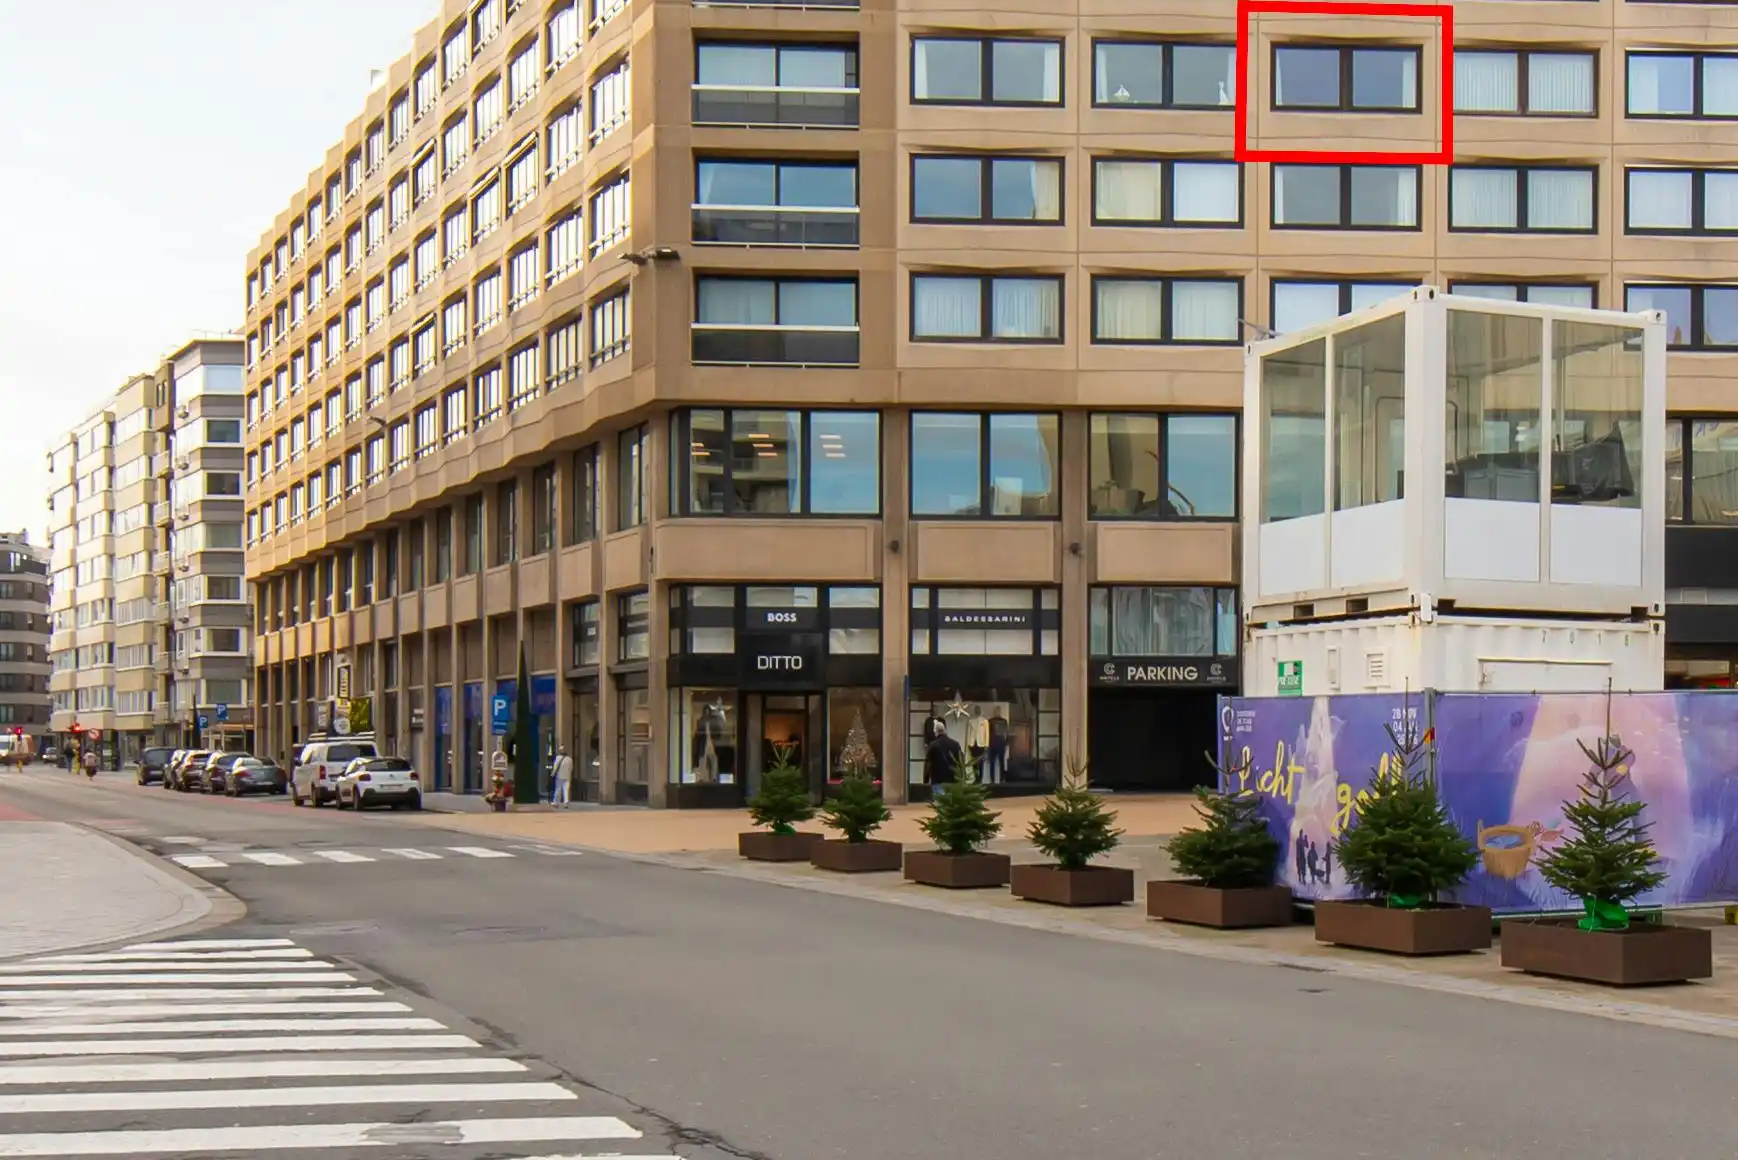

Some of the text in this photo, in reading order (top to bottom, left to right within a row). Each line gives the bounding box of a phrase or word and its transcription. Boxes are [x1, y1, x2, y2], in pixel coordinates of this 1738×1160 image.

[767, 612, 797, 623] BOSS
[944, 615, 1026, 623] BALDESSARINI
[757, 655, 802, 670] DITTO
[1127, 666, 1198, 681] PARKING
[495, 699, 506, 717] P
[1238, 739, 1305, 805] Licht
